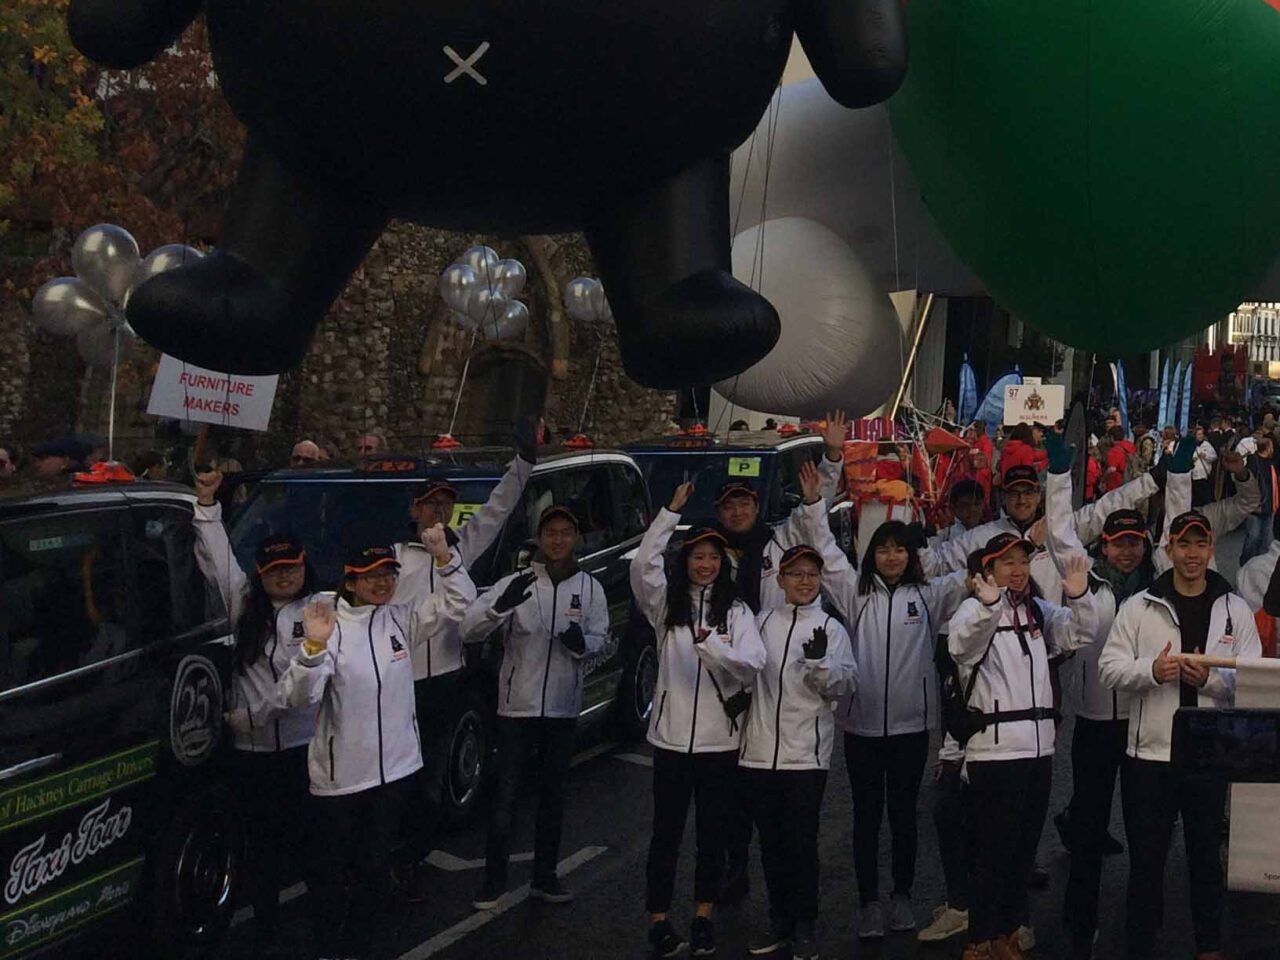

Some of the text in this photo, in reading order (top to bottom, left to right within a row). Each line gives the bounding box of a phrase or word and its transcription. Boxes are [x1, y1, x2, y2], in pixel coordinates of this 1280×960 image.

[180, 372, 254, 397] FURNITURE
[1008, 388, 1019, 398] 97
[183, 395, 239, 416] MAKERS
[739, 463, 750, 472] P
[4, 796, 132, 904] Taxi Tour
